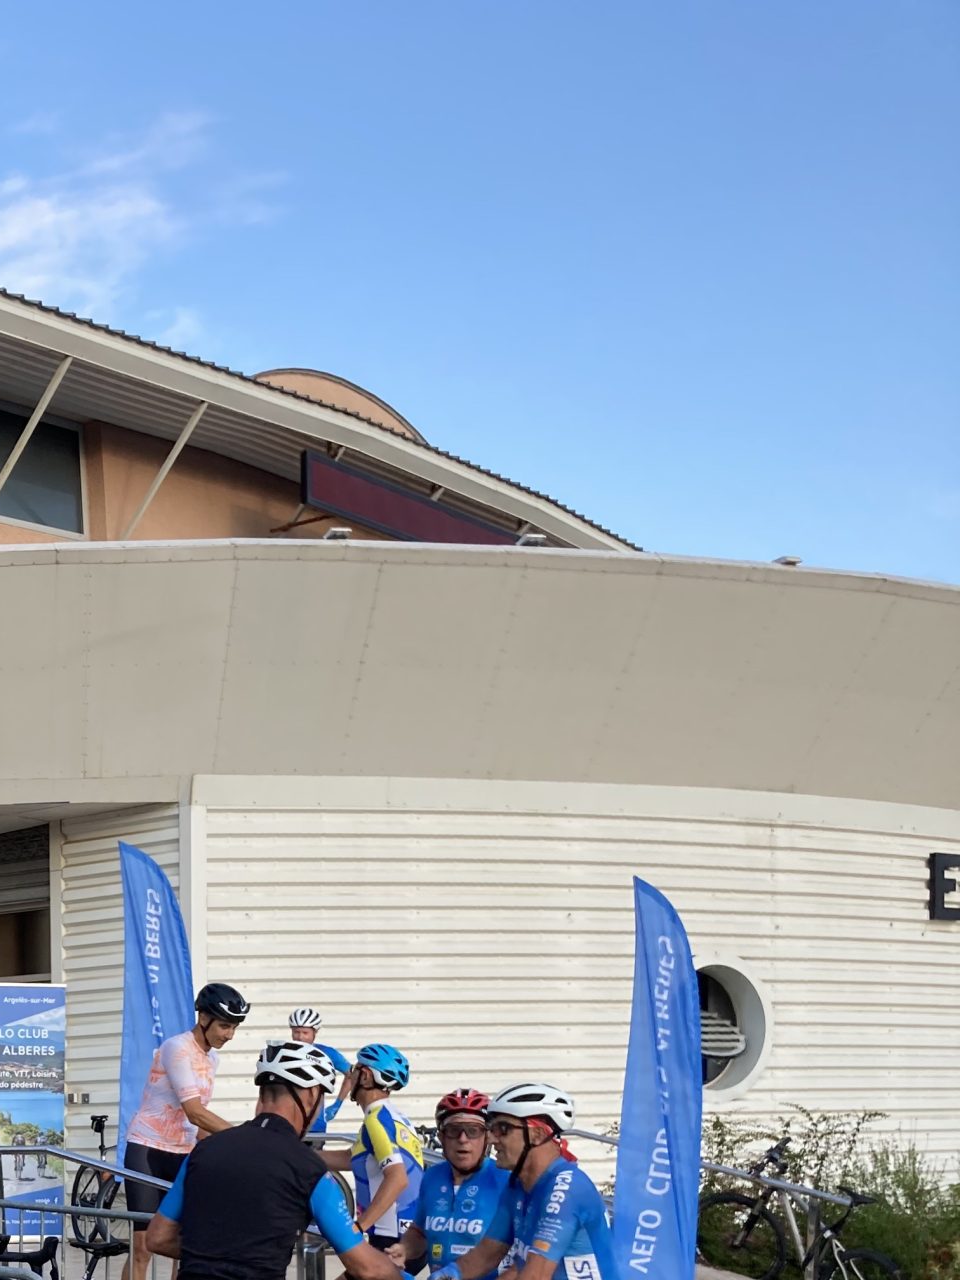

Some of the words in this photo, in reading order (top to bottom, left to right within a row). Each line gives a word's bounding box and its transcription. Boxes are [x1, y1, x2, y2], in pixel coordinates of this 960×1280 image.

[17, 1028, 49, 1039] CLUB
[2, 1045, 56, 1056] ALBERES
[10, 1080, 44, 1090] pédestre
[545, 1170, 574, 1215] VCA66
[425, 1215, 484, 1235] VCA66
